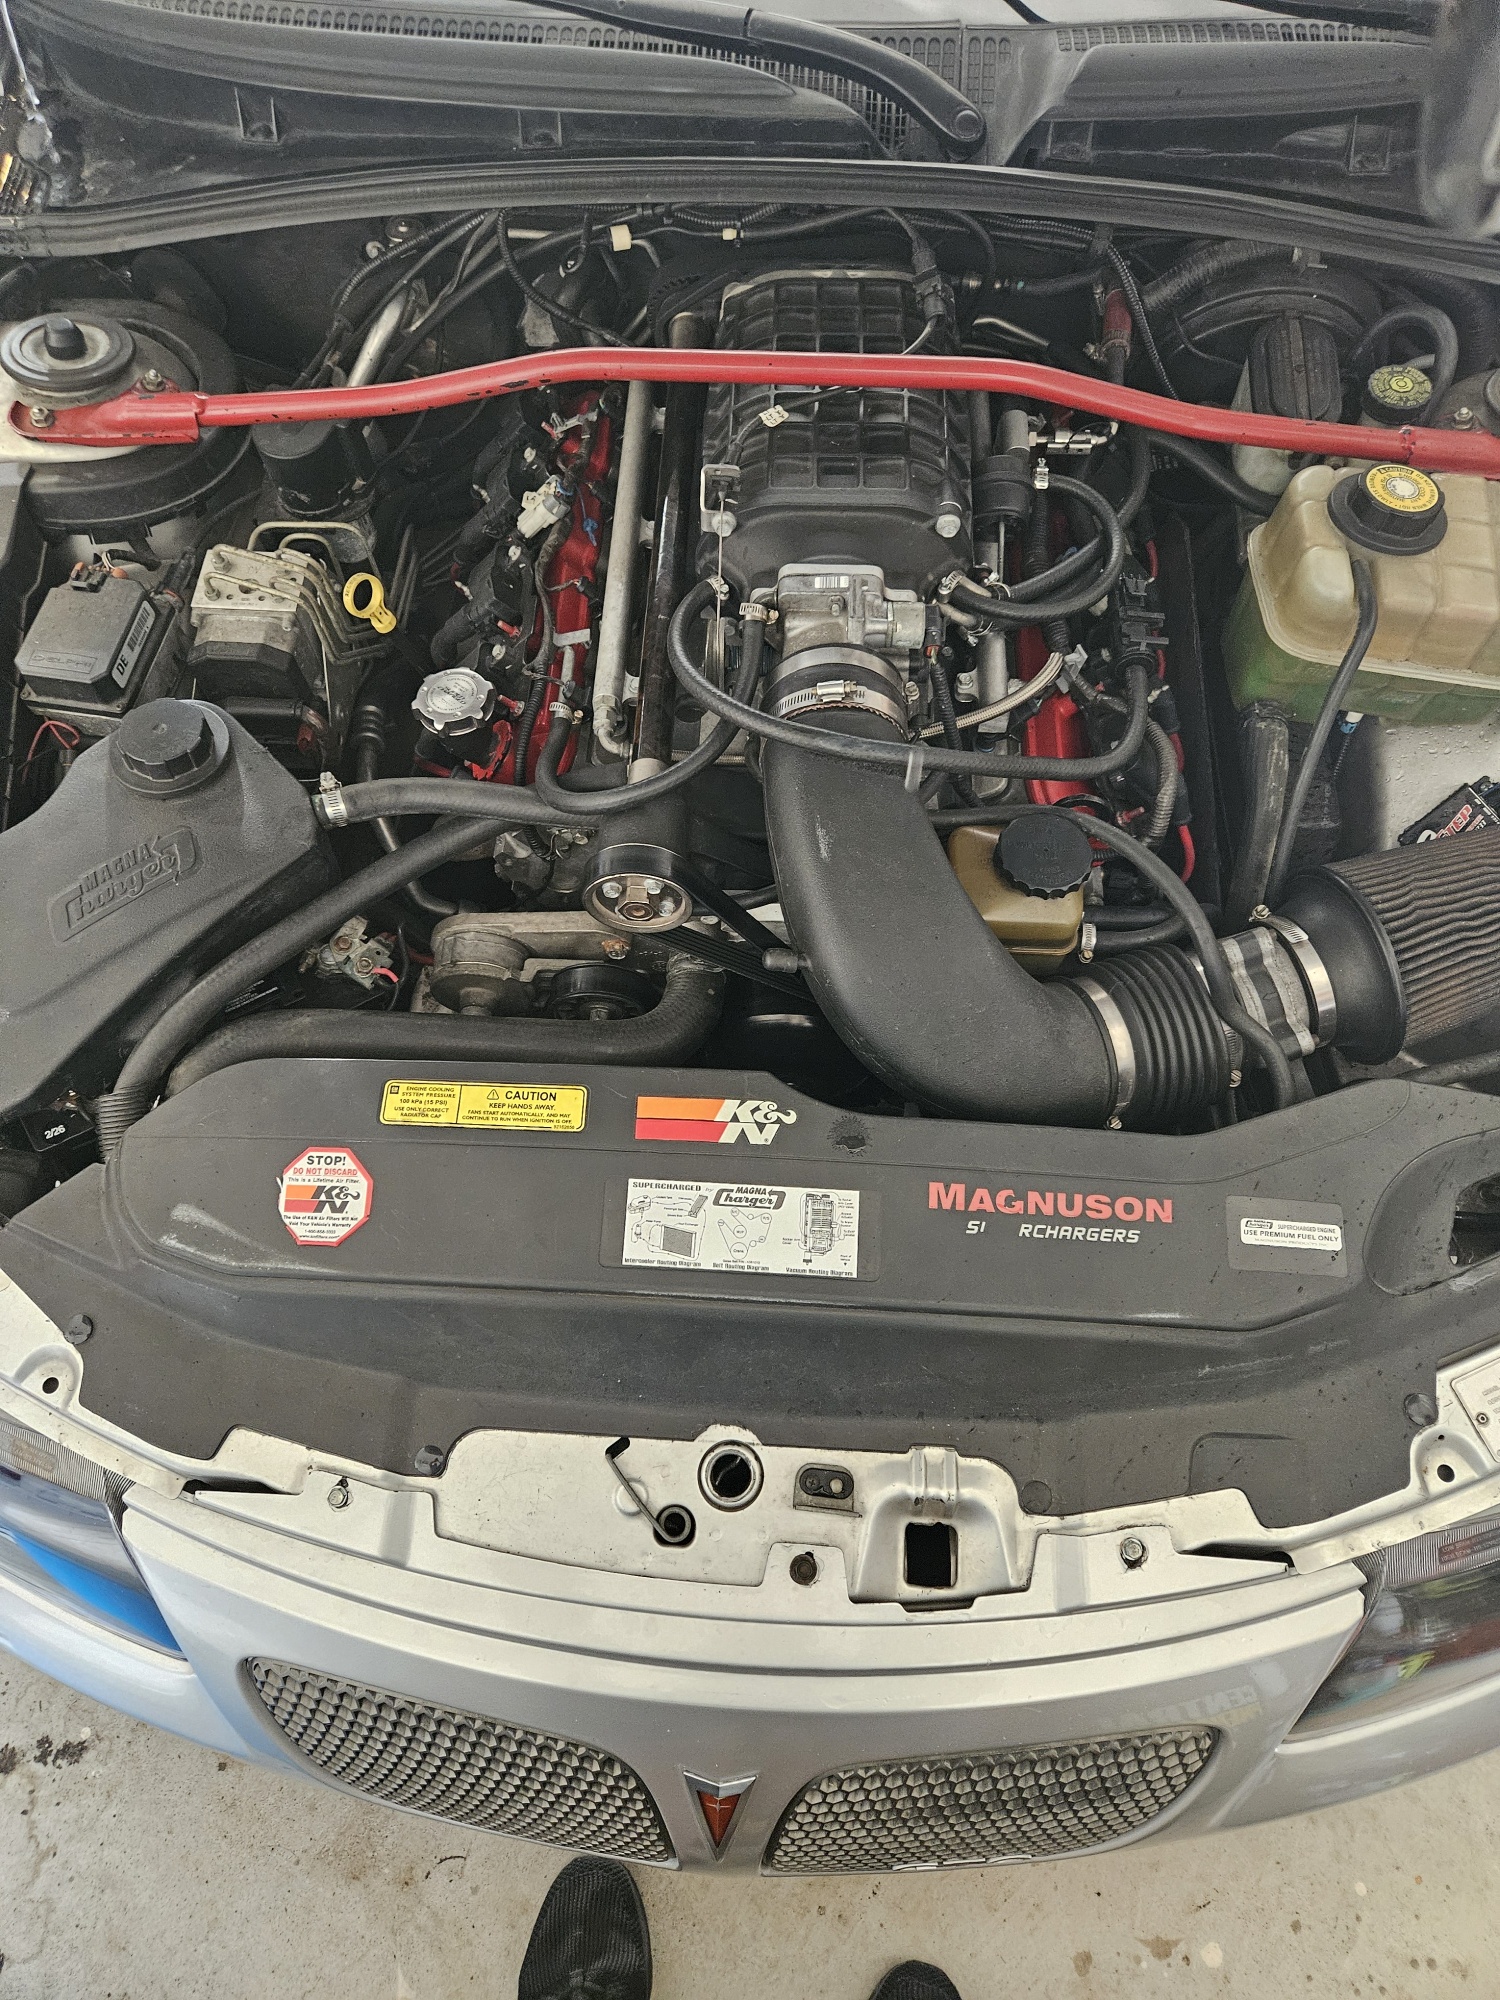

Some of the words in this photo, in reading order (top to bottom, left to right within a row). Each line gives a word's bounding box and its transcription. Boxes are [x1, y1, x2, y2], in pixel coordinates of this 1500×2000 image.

[505, 1090, 557, 1101] CAUTION
[534, 1103, 556, 1111] AWAY.
[714, 1098, 798, 1146] K&N
[44, 1124, 66, 1140] 2/26
[306, 1155, 347, 1166] STOP!
[293, 1167, 304, 1175] DO
[323, 1168, 358, 1176] DISCARD
[632, 1181, 702, 1192] SUPERCHARGED
[735, 1186, 767, 1196] MAGNA
[311, 1185, 361, 1214] K&N
[928, 1181, 1174, 1224] MAGNUSON
[1277, 1223, 1316, 1233] SUPERCHARGED
[1316, 1226, 1336, 1234] ENGINE
[1259, 1230, 1296, 1239] PREMIUM
[1297, 1233, 1317, 1241] FUEL
[1317, 1235, 1339, 1243] ONLY
[678, 1260, 702, 1268] Diagram
[746, 1264, 770, 1272] Diagram
[808, 1268, 829, 1276] Routing
[829, 1269, 854, 1277] Diagram
